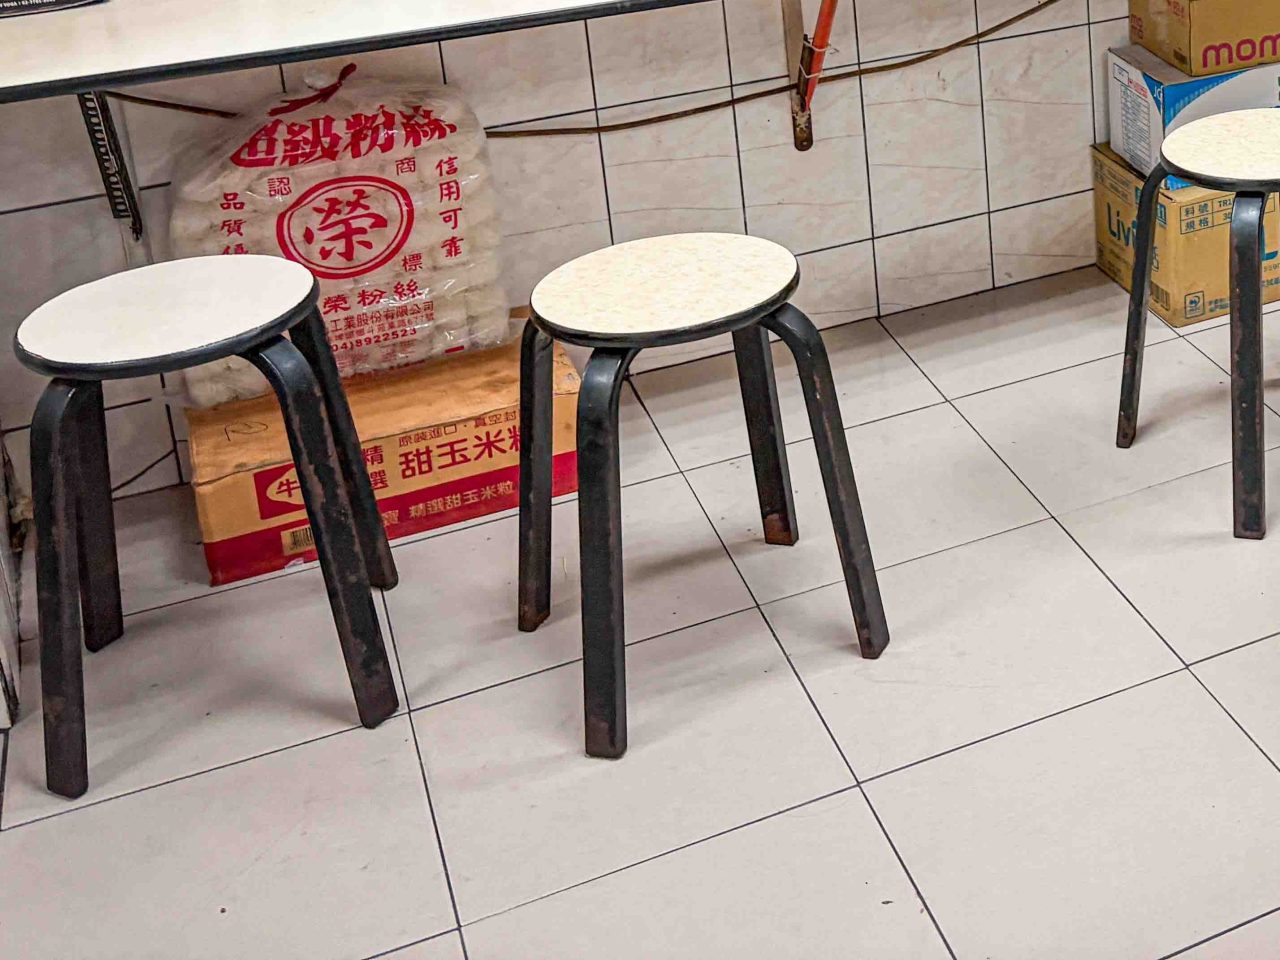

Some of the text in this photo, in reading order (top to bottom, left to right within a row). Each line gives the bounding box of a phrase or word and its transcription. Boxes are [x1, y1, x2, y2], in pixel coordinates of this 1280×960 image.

[303, 189, 388, 261] 榮
[435, 156, 464, 258] 信用可靠
